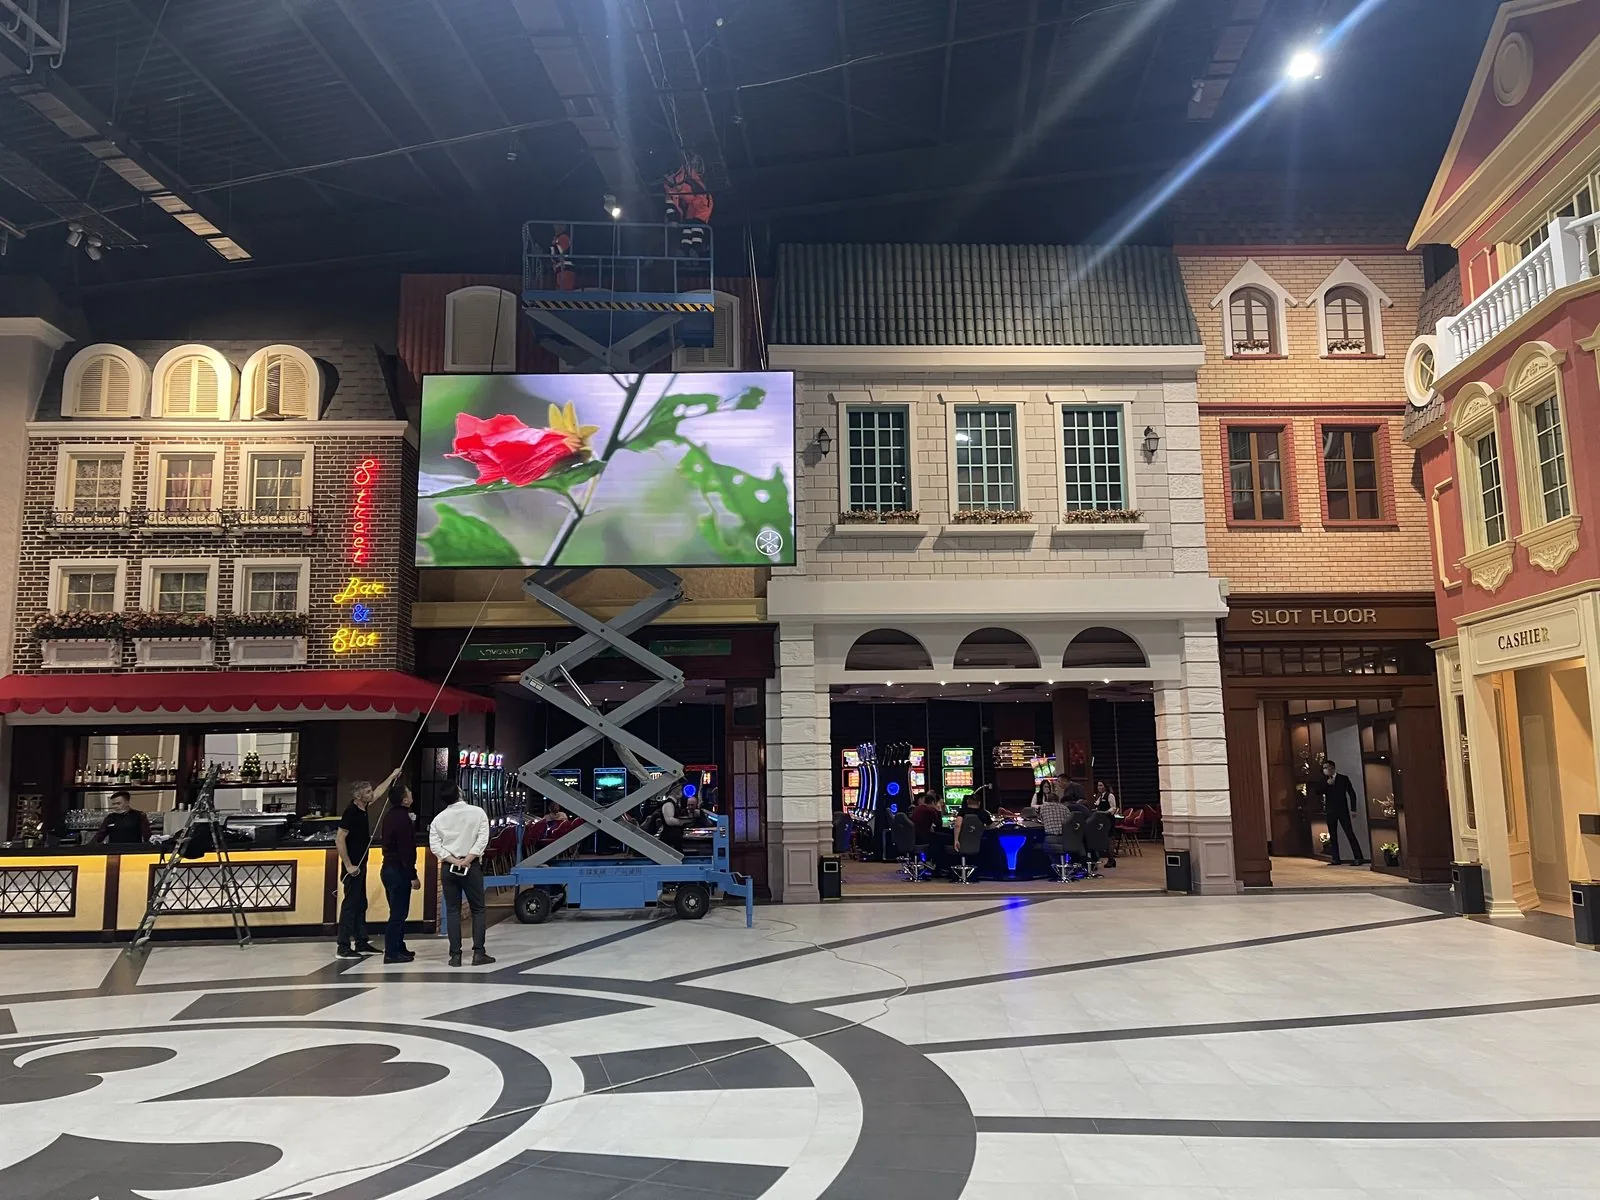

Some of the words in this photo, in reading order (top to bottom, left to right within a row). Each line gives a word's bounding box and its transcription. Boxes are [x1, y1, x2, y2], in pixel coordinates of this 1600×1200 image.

[353, 459, 375, 564] Street
[333, 577, 384, 603] Bar
[353, 604, 370, 622] &
[1251, 609, 1302, 625] SLOT
[1311, 608, 1377, 624] FLOOR
[332, 628, 377, 653] Slot
[1498, 627, 1550, 650] CASHIER
